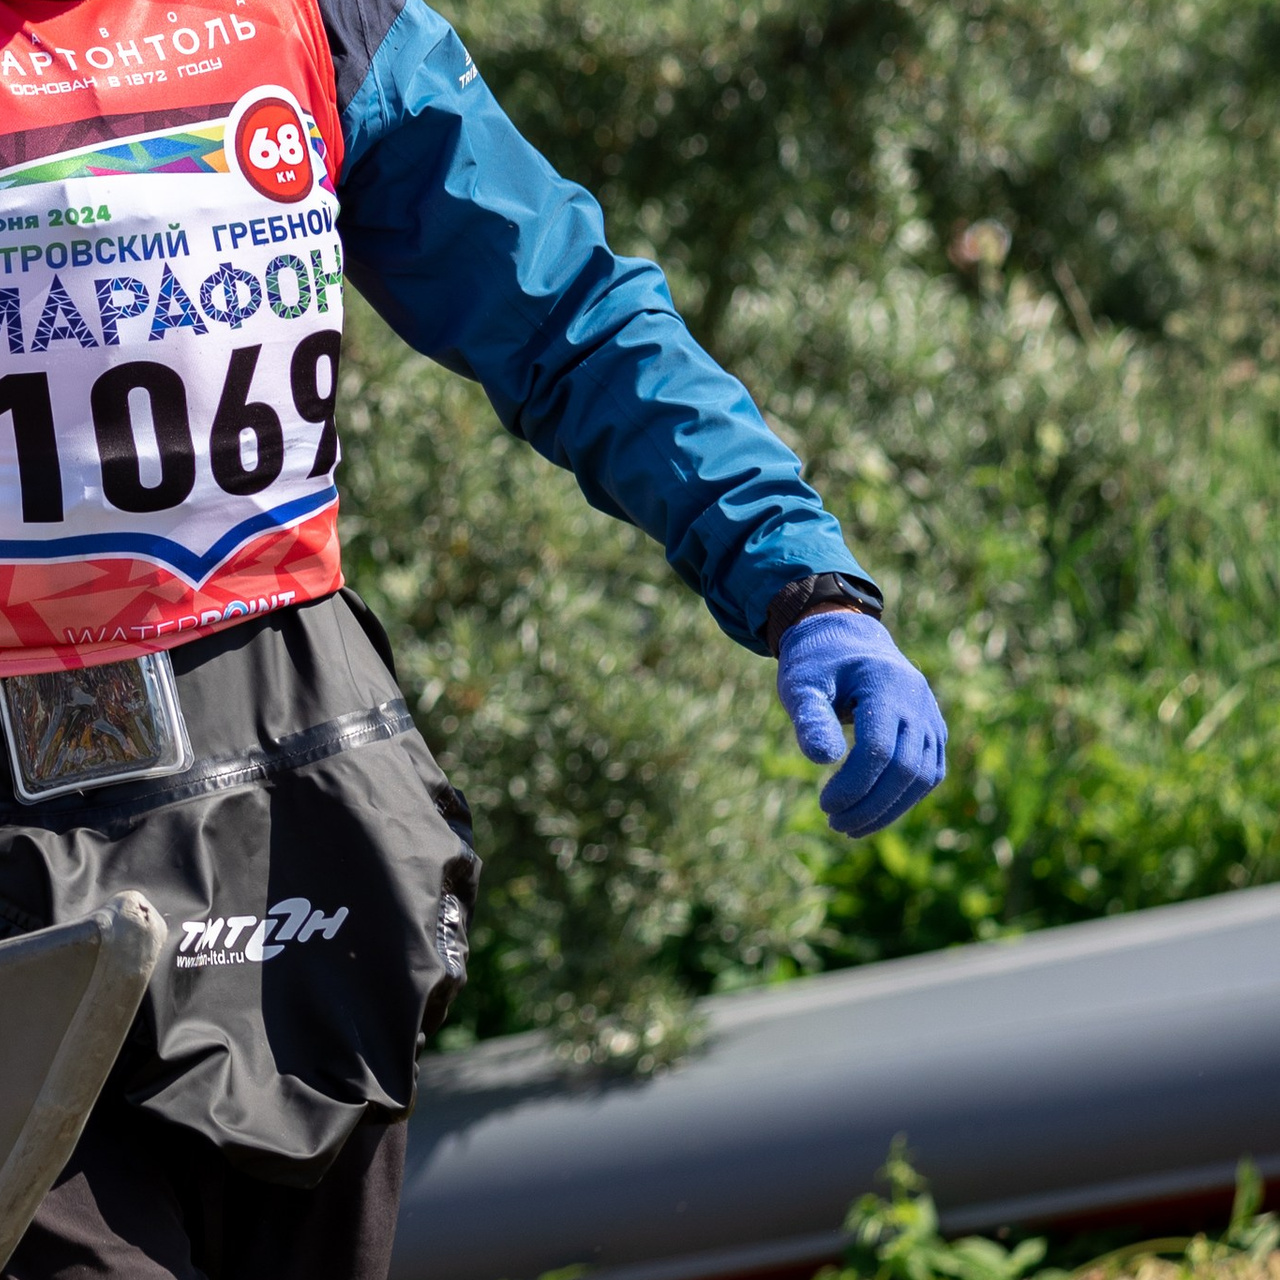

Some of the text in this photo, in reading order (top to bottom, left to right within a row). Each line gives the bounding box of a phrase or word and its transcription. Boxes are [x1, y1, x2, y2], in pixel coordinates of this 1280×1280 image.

[10, 76, 98, 96] ОСНОВАН
[125, 69, 168, 86] 1872
[177, 56, 223, 78] ГОДУ
[248, 123, 304, 170] 68
[47, 204, 112, 227] 2024
[211, 200, 334, 252] ГРЕБНОЙ
